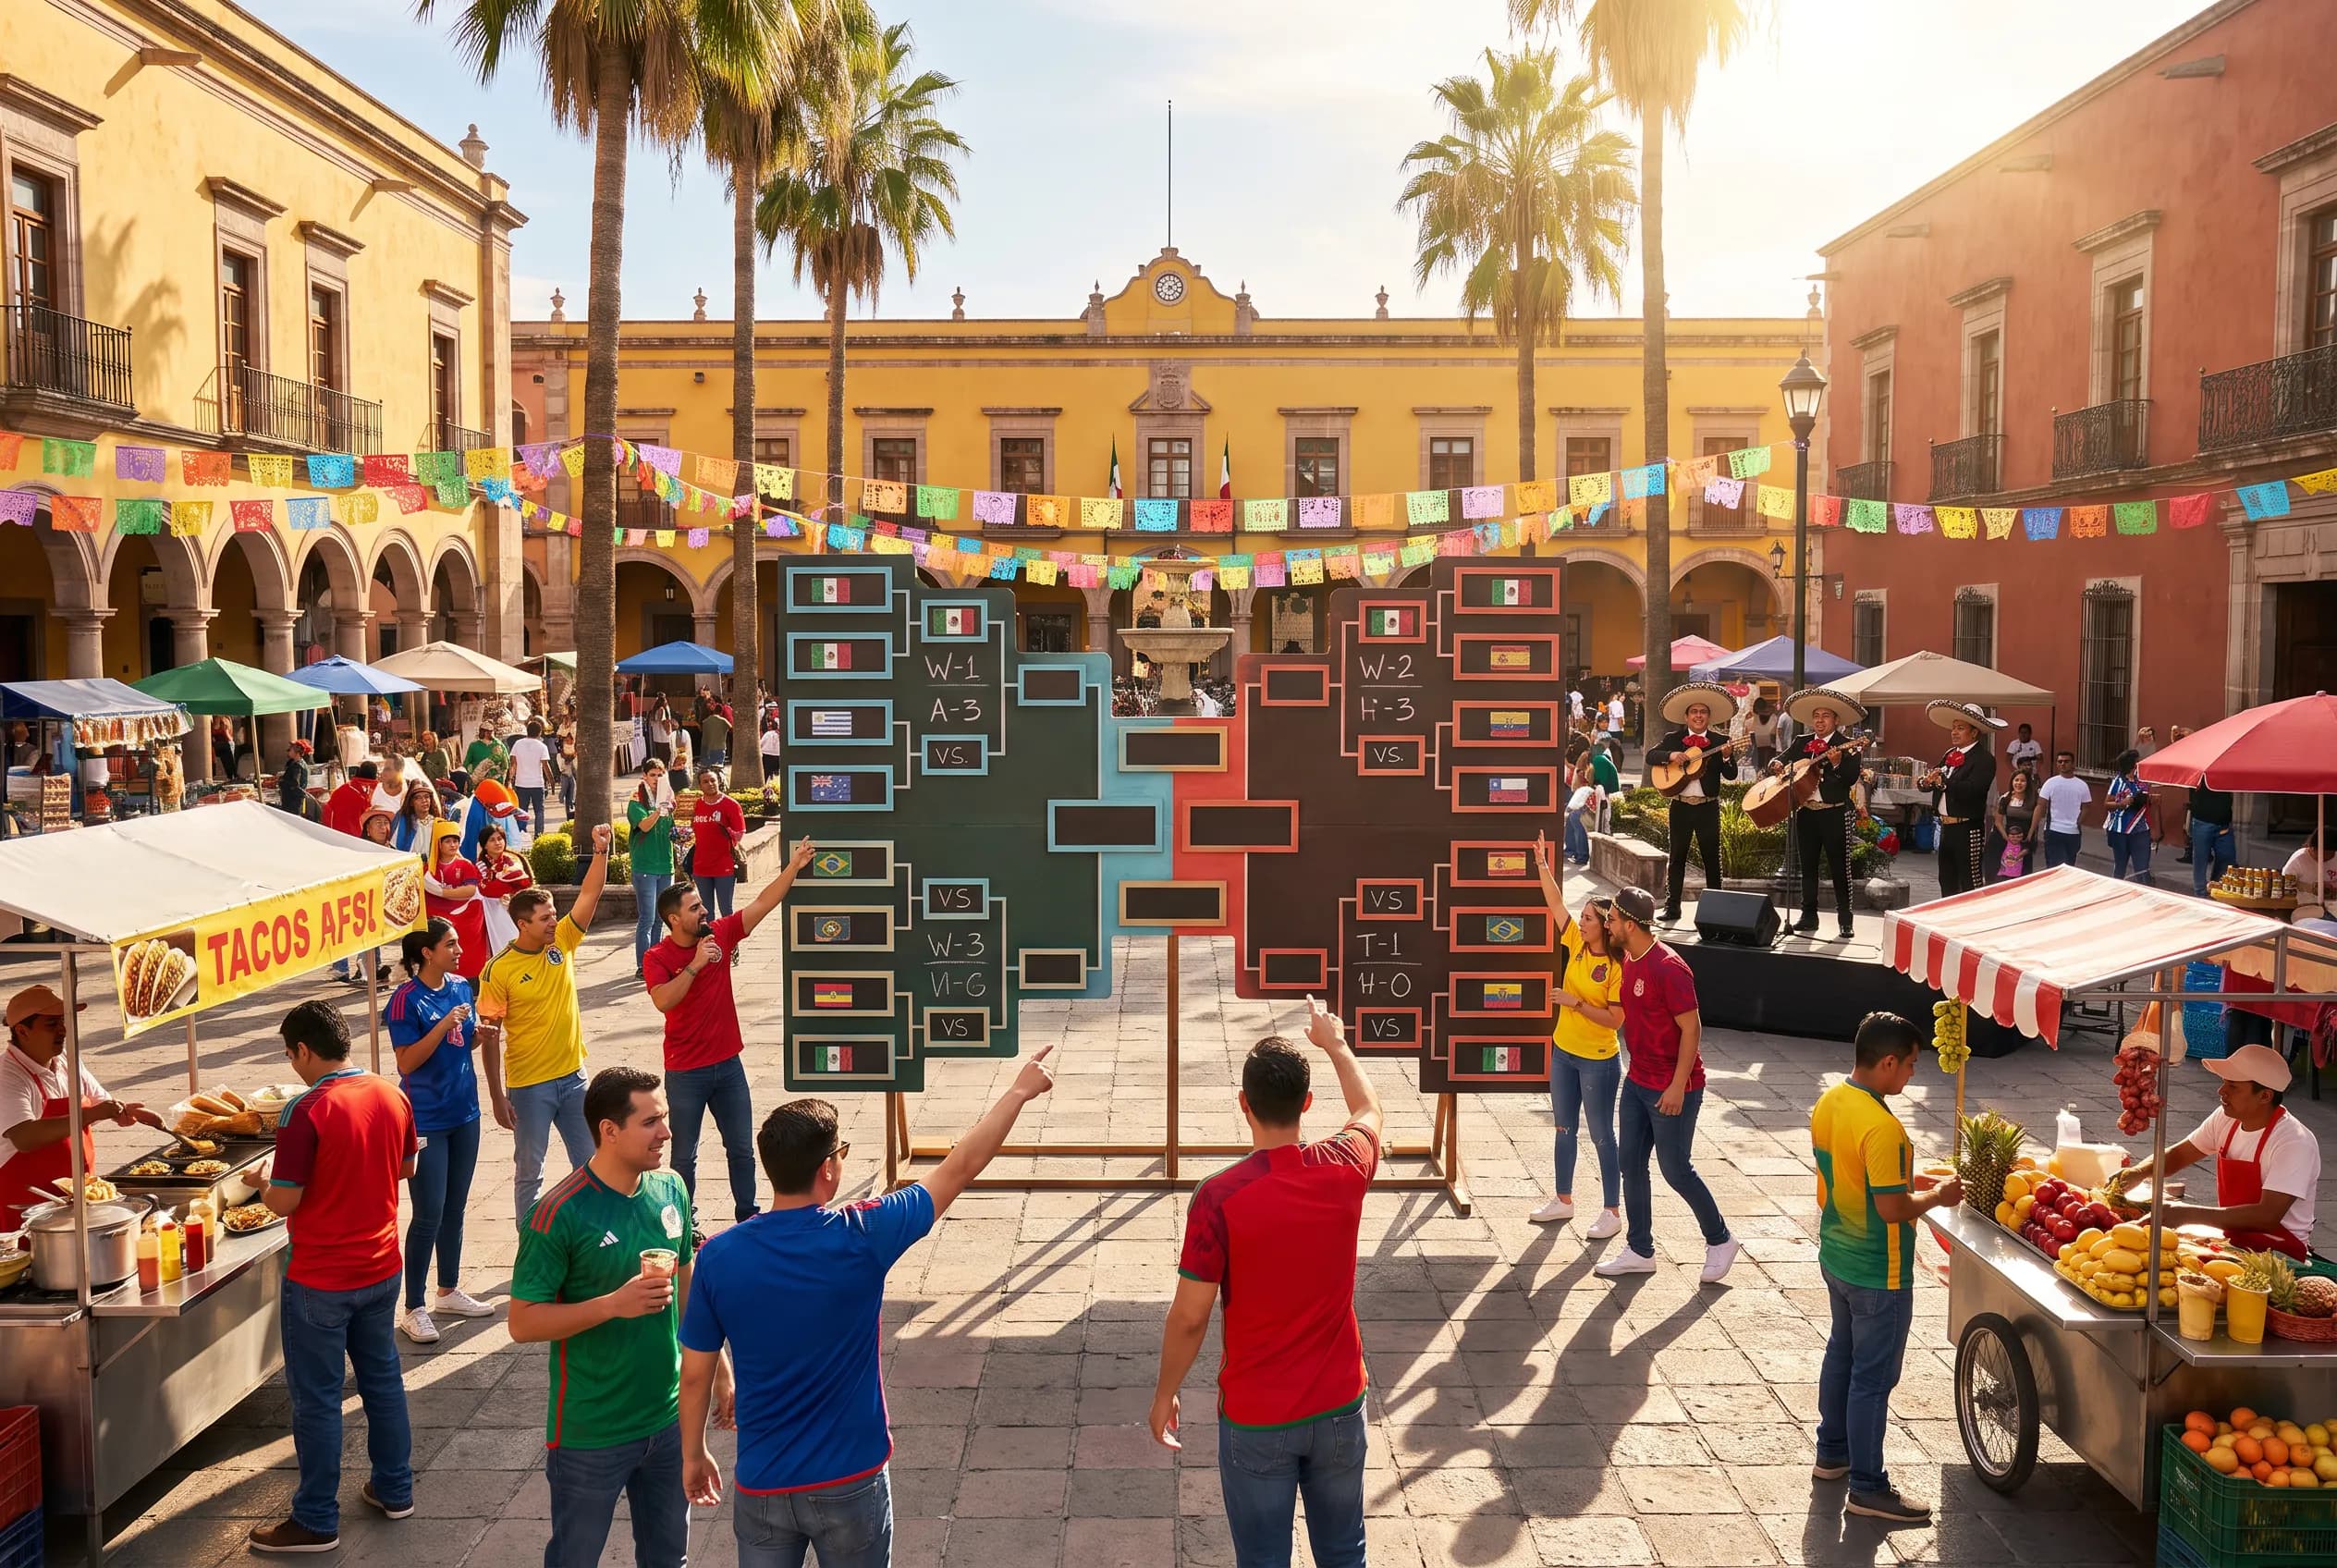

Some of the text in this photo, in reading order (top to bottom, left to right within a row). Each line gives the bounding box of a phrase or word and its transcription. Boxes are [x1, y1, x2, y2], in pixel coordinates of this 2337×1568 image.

[924, 653, 980, 681] W-1
[1359, 653, 1413, 680] W-2
[930, 698, 981, 723] A-3
[937, 888, 972, 909] VS
[1370, 890, 1402, 911] VS
[207, 888, 377, 986] TACOS AFS!
[927, 932, 985, 957] W-3
[1355, 932, 1401, 957] T-1
[941, 1018, 968, 1036] VS
[1371, 1018, 1401, 1037] VS
